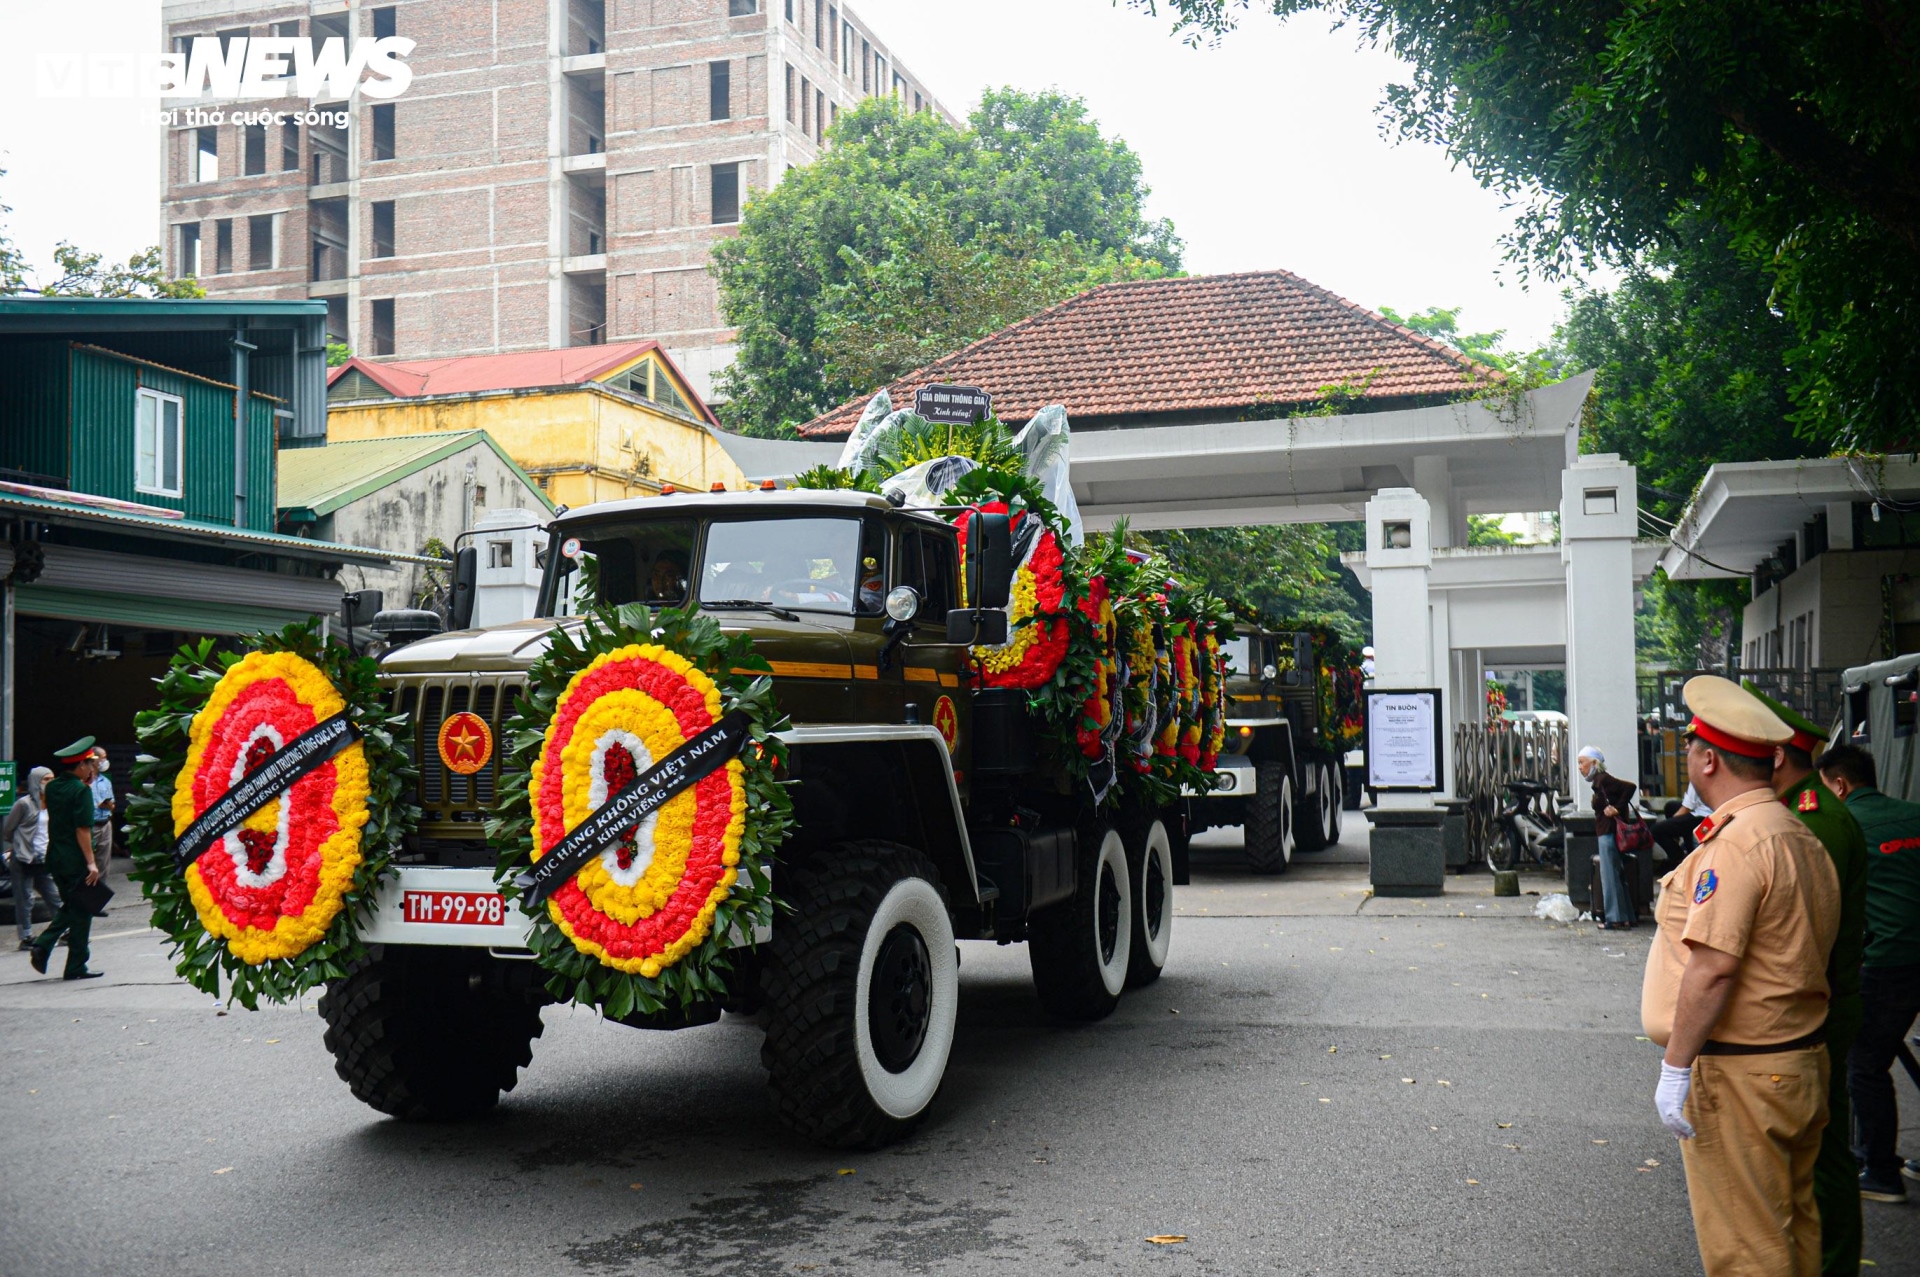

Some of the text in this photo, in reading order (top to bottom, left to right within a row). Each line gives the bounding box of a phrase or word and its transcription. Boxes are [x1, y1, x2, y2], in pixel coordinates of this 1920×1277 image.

[921, 391, 985, 406] GIA ĐÌNH THÔNG GIA
[314, 729, 331, 745] CỤC
[224, 805, 250, 827] KÍNH
[249, 782, 280, 808] VIẾNG
[534, 729, 728, 882] CỤC HÀNG KHÔNG VIỆT NAM
[596, 788, 667, 845] KÍNH VIẾNG
[408, 894, 501, 922] TM-99-98
